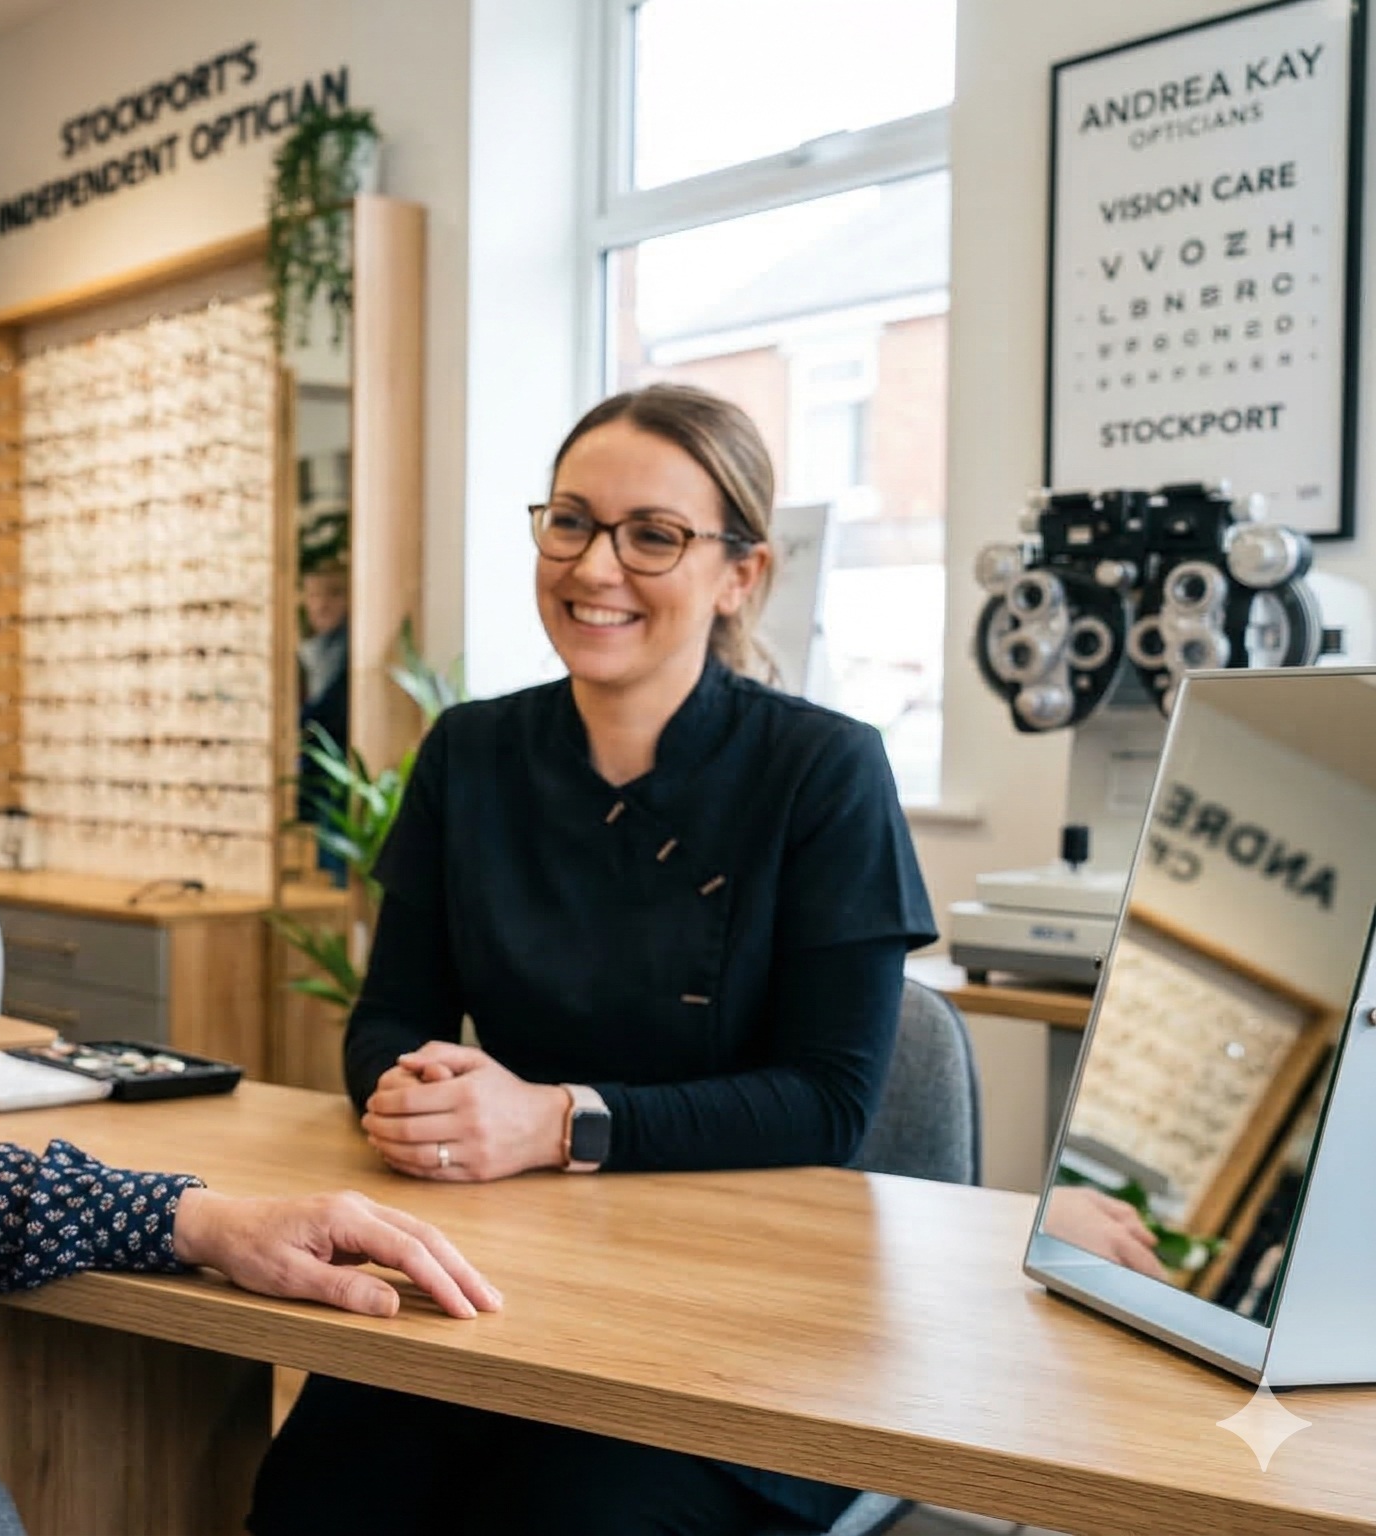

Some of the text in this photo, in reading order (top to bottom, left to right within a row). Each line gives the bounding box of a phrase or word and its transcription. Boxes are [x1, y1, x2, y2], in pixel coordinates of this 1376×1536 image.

[60, 40, 259, 159] STOCKPORT'S
[191, 66, 348, 161] OPTICIAN
[1081, 44, 1324, 130] ANDREA KAY
[1128, 101, 1264, 150] OPTICIANS
[1099, 162, 1294, 223] VISION CARE
[1268, 222, 1295, 249] H
[1100, 403, 1286, 448] STOCKPORT
